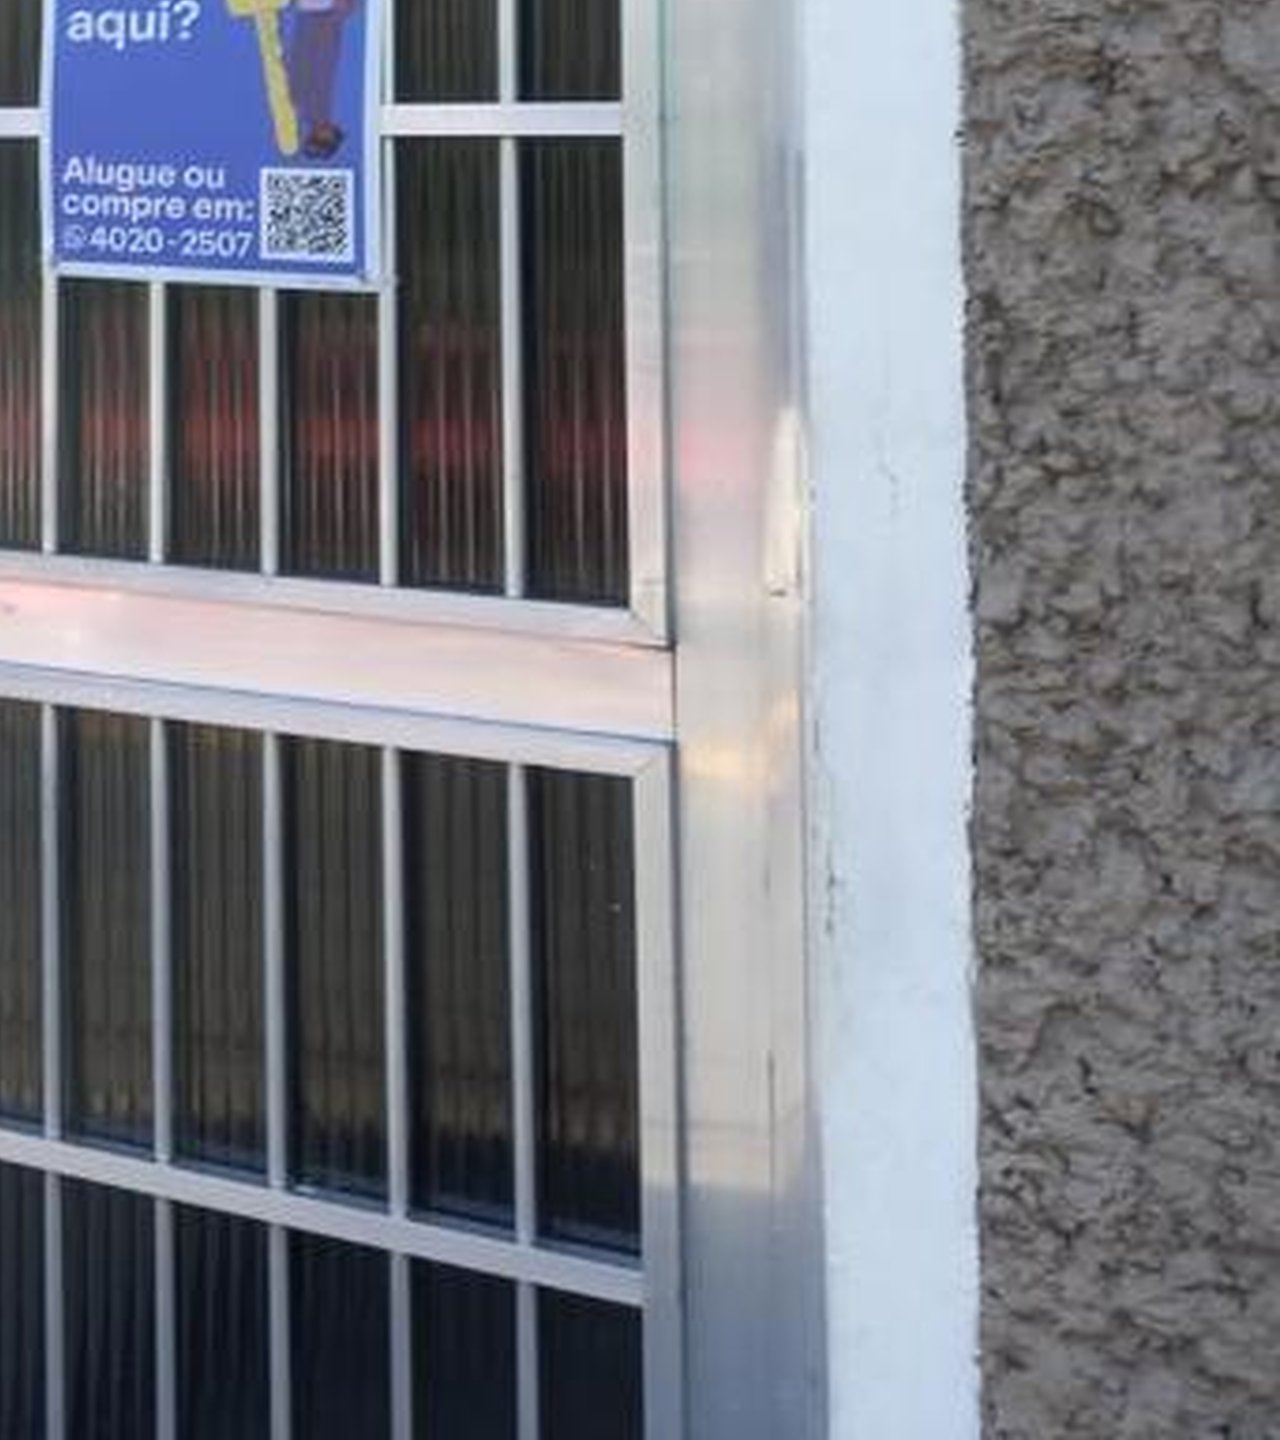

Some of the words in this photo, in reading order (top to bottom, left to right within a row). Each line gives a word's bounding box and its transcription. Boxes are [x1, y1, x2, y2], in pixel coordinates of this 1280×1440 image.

[66, 0, 202, 49] aqui?
[62, 156, 176, 192] Alugue
[183, 166, 225, 189] ou
[61, 193, 186, 222] compre
[192, 197, 255, 221] em:
